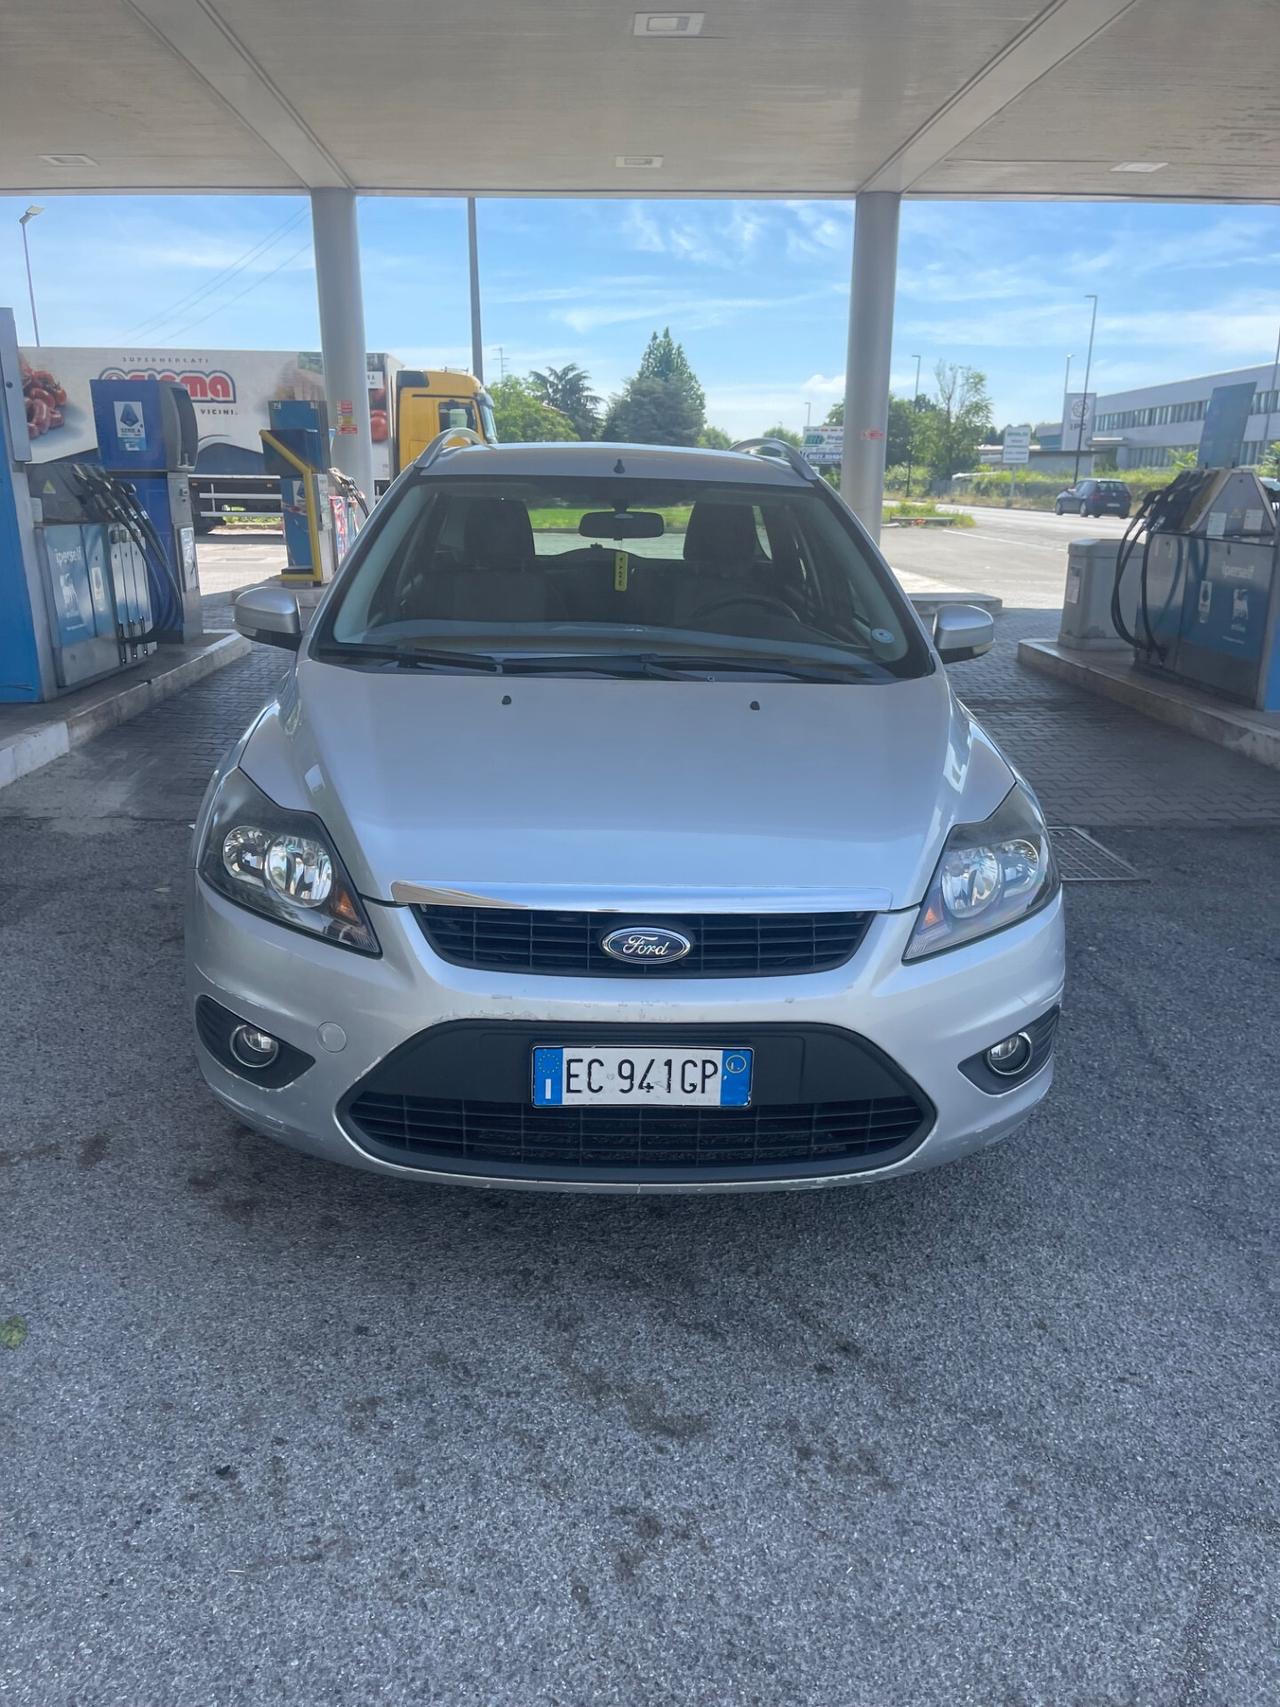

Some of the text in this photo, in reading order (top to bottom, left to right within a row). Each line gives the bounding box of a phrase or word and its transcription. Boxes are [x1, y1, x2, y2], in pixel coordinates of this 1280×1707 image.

[622, 934, 671, 956] Ford
[565, 1058, 605, 1094] EC
[617, 1058, 719, 1095] 941GP
